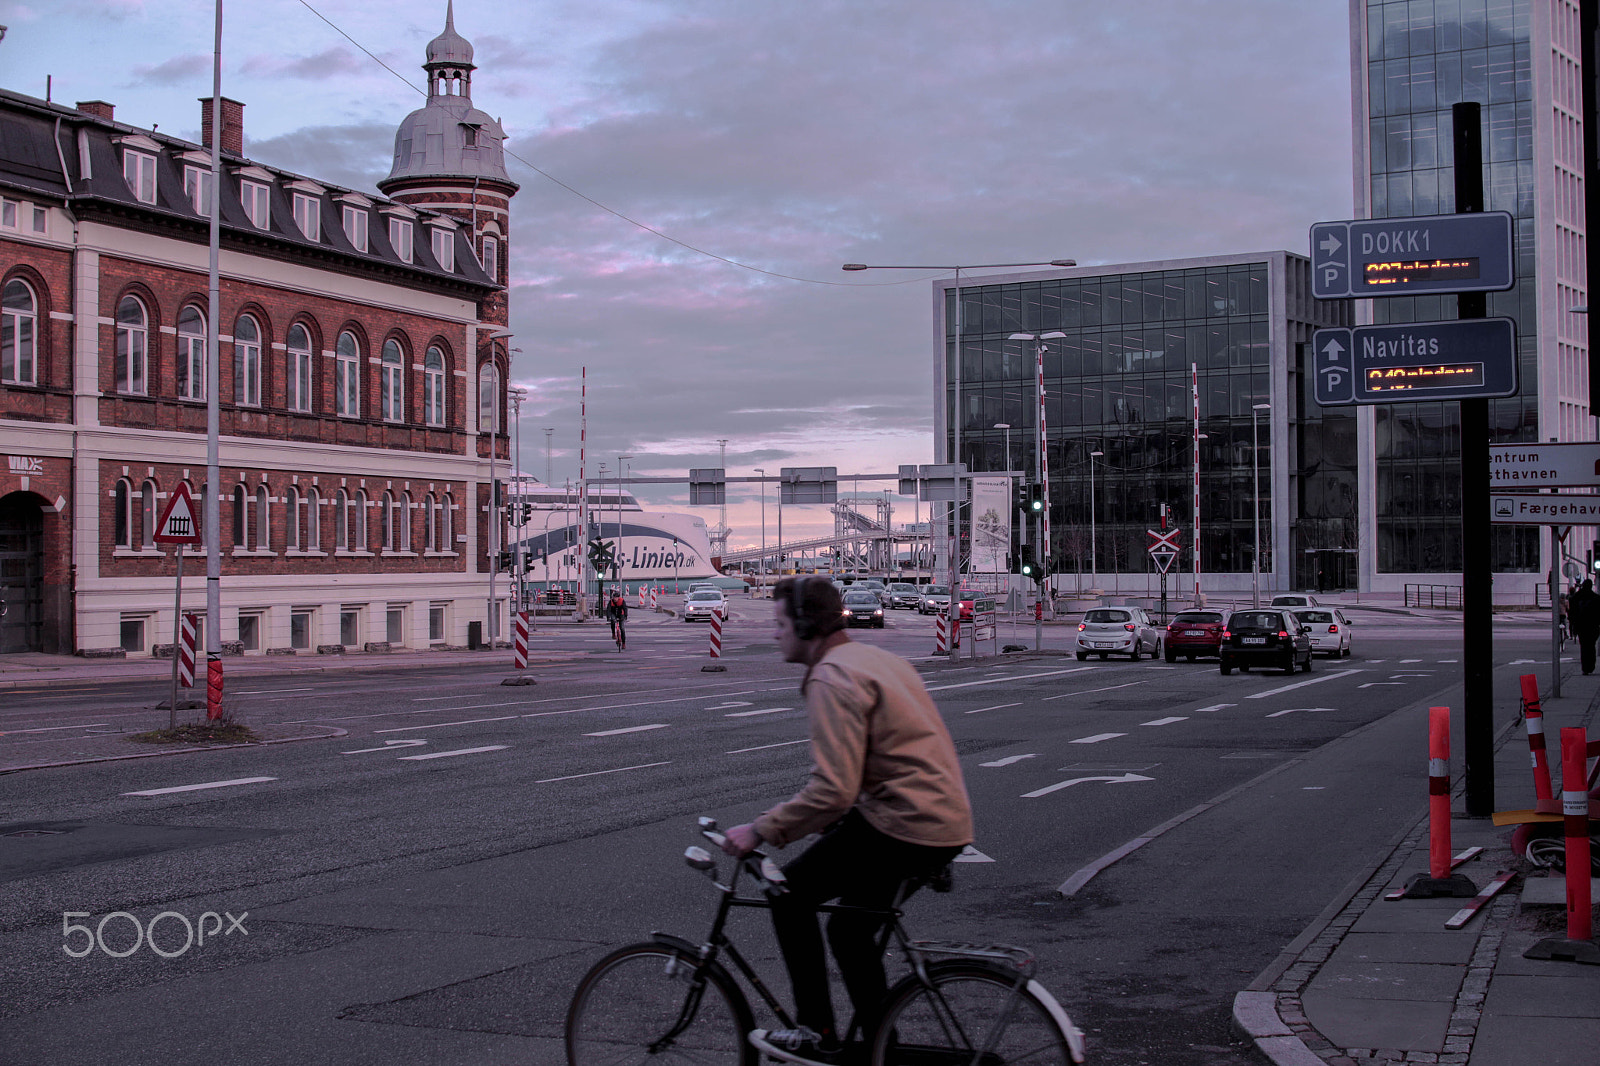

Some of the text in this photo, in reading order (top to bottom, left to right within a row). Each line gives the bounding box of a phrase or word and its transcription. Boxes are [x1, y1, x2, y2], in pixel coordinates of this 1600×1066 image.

[1362, 229, 1430, 255] DOKK1
[1324, 268, 1339, 288] P
[1363, 334, 1439, 359] Navitas
[1327, 373, 1342, 392] P
[1488, 452, 1539, 463] entrum
[1488, 468, 1557, 480] sthavnen
[1520, 502, 1600, 516] Færgehav
